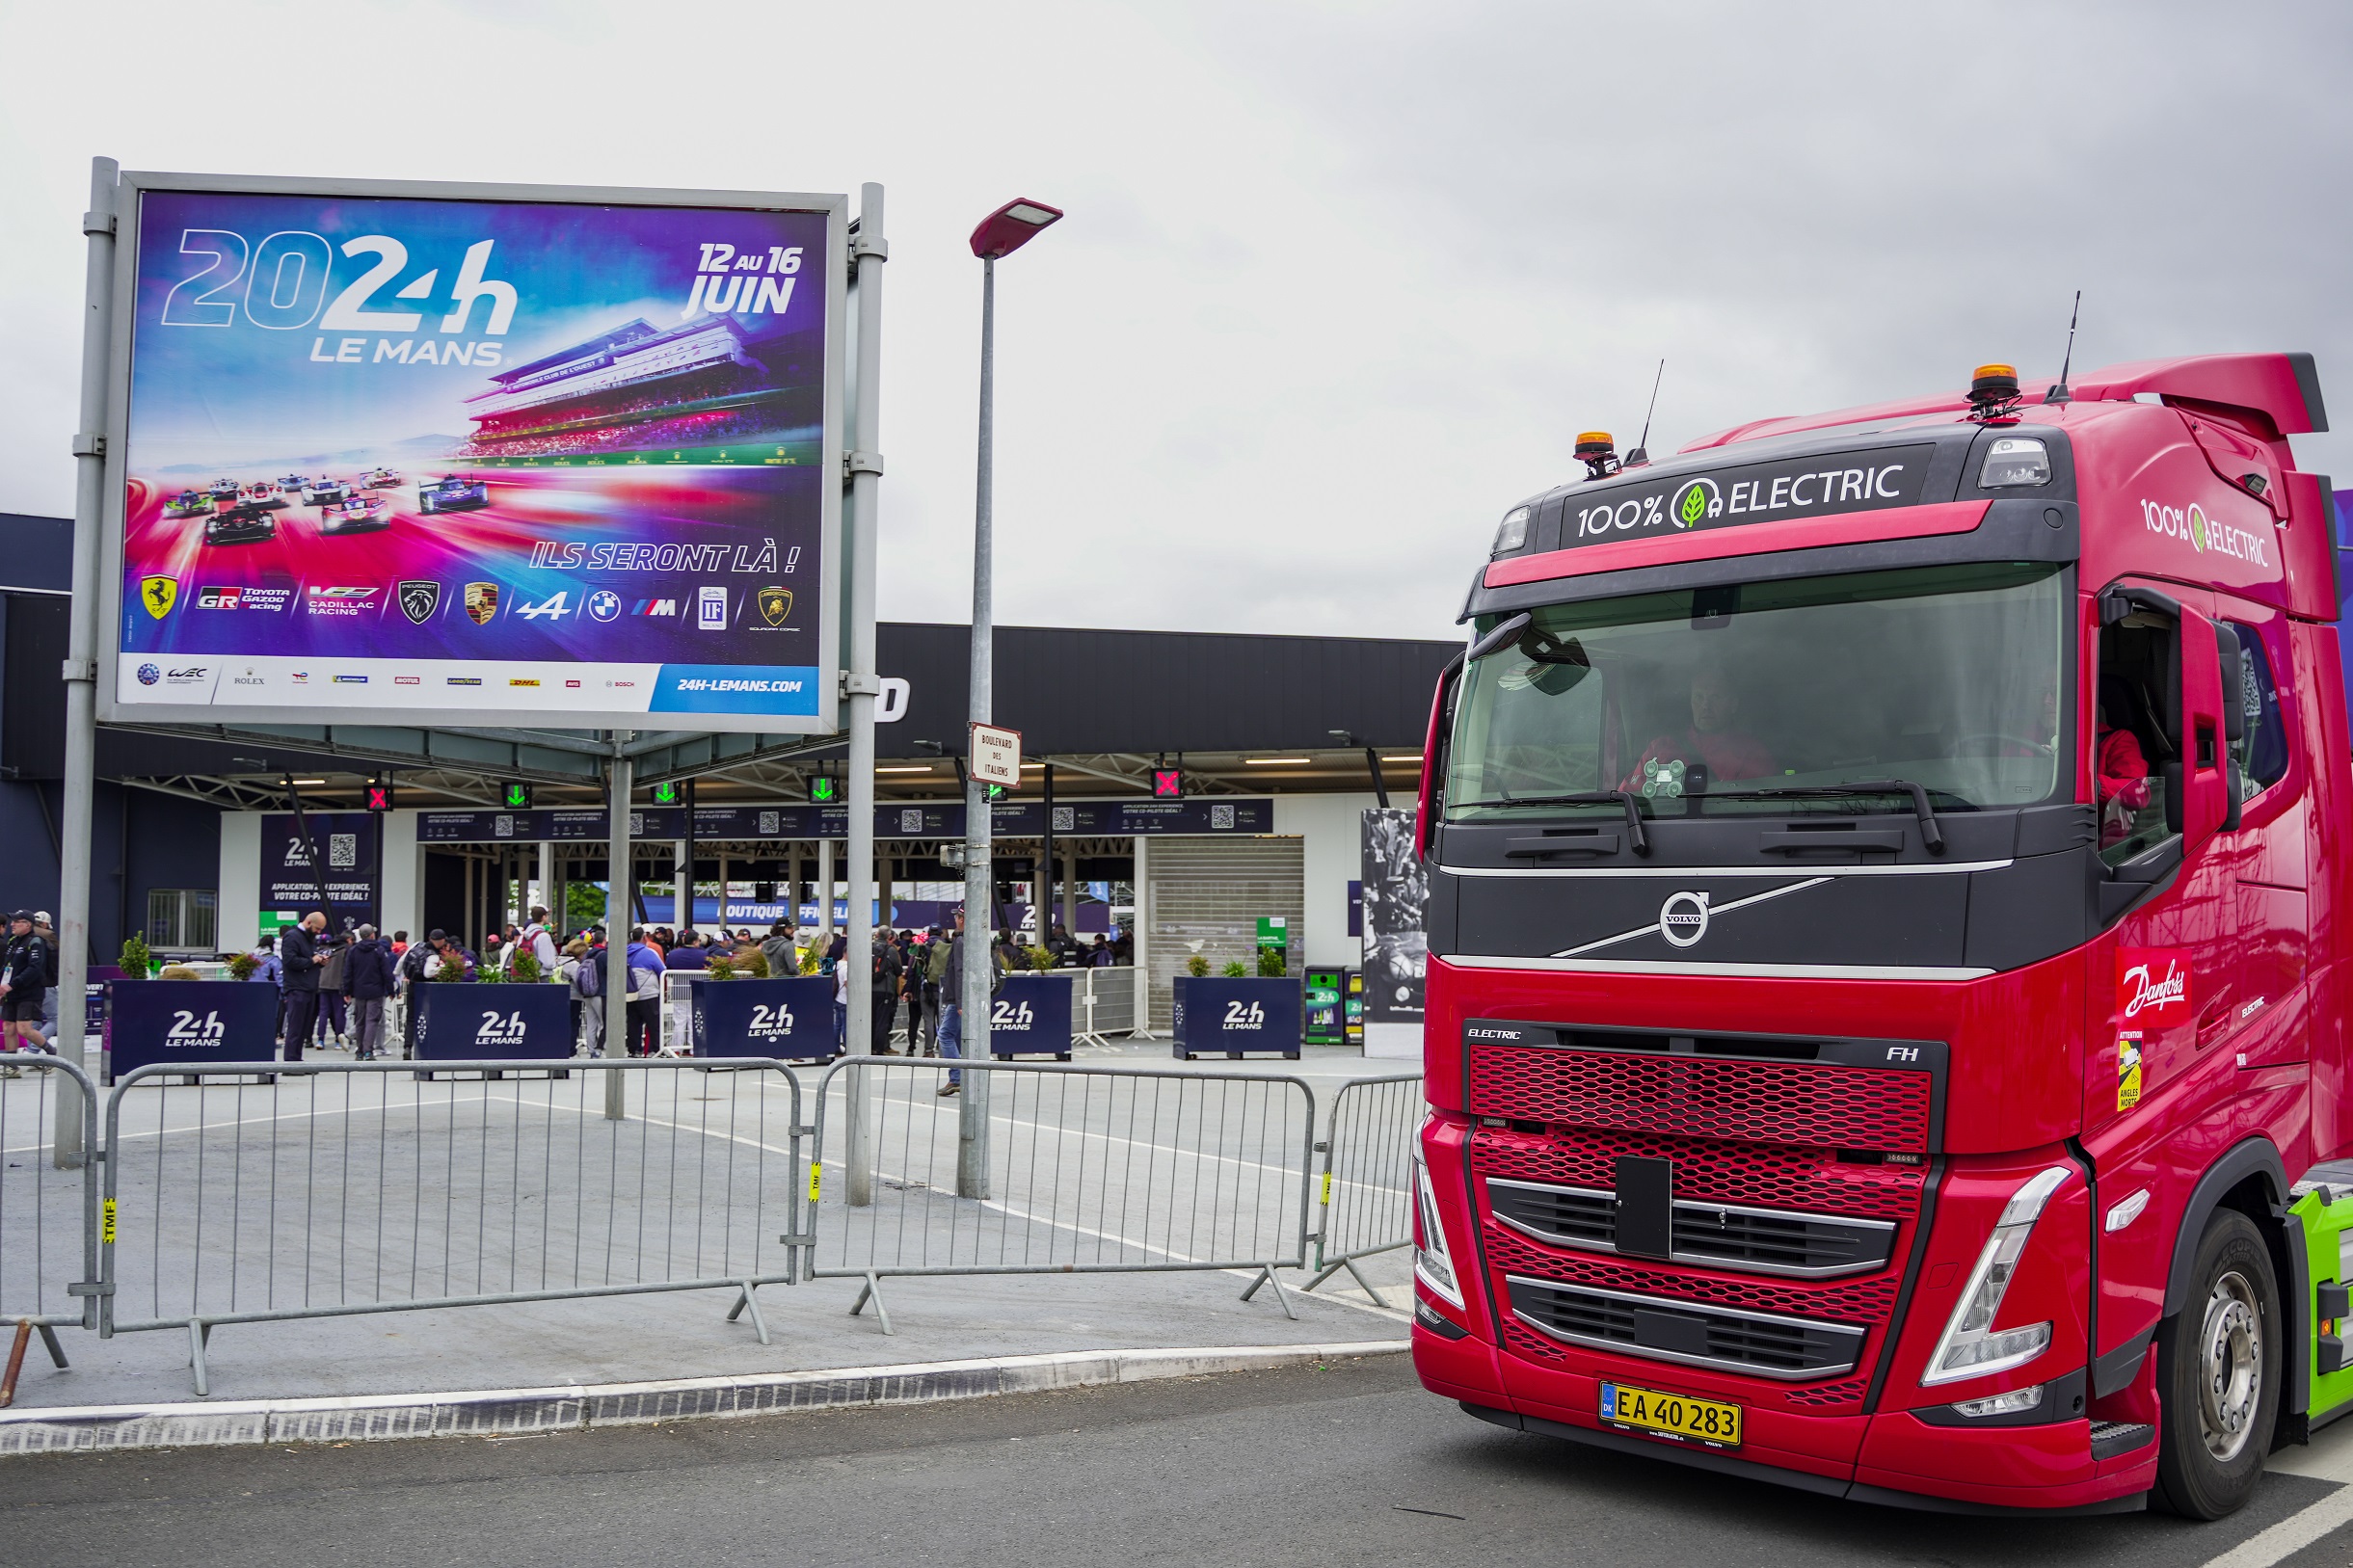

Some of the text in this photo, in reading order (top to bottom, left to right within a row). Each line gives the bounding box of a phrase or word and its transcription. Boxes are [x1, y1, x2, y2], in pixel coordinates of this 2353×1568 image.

[697, 243, 804, 276] 12 AU 16
[680, 276, 797, 320] JUIN
[309, 336, 502, 367] LE MANS
[1577, 465, 1904, 538] 100% ELECTRIC
[2139, 497, 2269, 568] 100% ELECTRIC
[528, 538, 802, 573] ILS SERONT LÀ !
[198, 595, 239, 609] GR
[242, 595, 285, 603] GAZOO
[308, 600, 375, 609] CADILLAC
[704, 601, 722, 620] IF
[677, 678, 802, 694] 24H-LEMANS.COM
[982, 734, 1012, 749] BOULEVARD
[993, 752, 1002, 760] DES
[984, 763, 1008, 777] ITALIENS
[328, 883, 371, 891] EXPERIENCE,
[274, 891, 301, 901] VOTRE
[340, 890, 364, 901] IDÉAL
[717, 905, 785, 918] OUTIQUE
[2123, 958, 2185, 1018] Danfoss
[1317, 992, 1335, 1002] 24h
[991, 1000, 1033, 1024] 24h
[1223, 1000, 1265, 1023] 24h
[2241, 996, 2265, 1019] ELECTRIC
[477, 1010, 526, 1037] 24h
[749, 1003, 794, 1029] 24h
[168, 1010, 226, 1039] 24h
[762, 1027, 791, 1036] MANS
[491, 1036, 523, 1046] MANS
[1467, 1028, 1521, 1040] ELECTRIC
[2119, 1030, 2143, 1040] ATTENTION
[165, 1038, 222, 1048] LE MANS
[1886, 1046, 1919, 1063] FH
[2120, 1088, 2139, 1098] ANGLES
[2120, 1097, 2138, 1107] MORTS
[105, 1205, 115, 1237] TMF
[1603, 1391, 1736, 1437] DK EA 40 283
